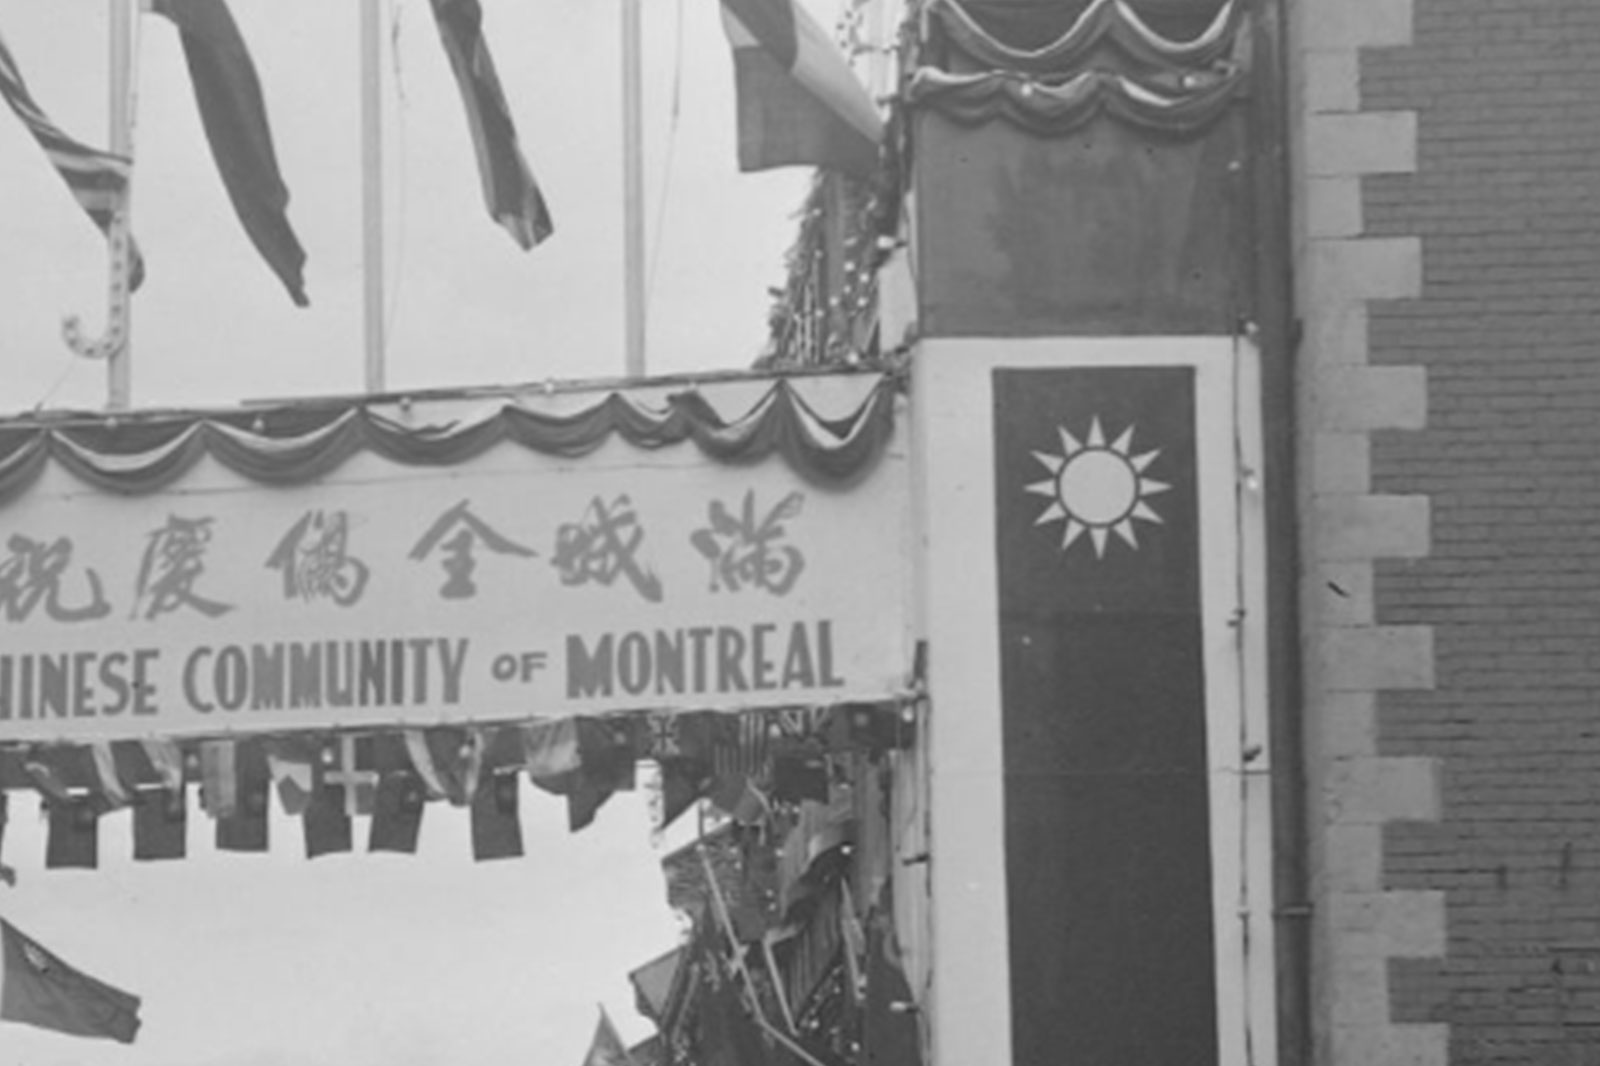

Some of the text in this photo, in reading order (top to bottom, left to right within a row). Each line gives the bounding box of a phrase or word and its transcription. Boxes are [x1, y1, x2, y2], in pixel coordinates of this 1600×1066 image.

[183, 637, 471, 714] COMMUNITY
[491, 650, 549, 686] OF
[565, 619, 846, 699] MONTREAL
